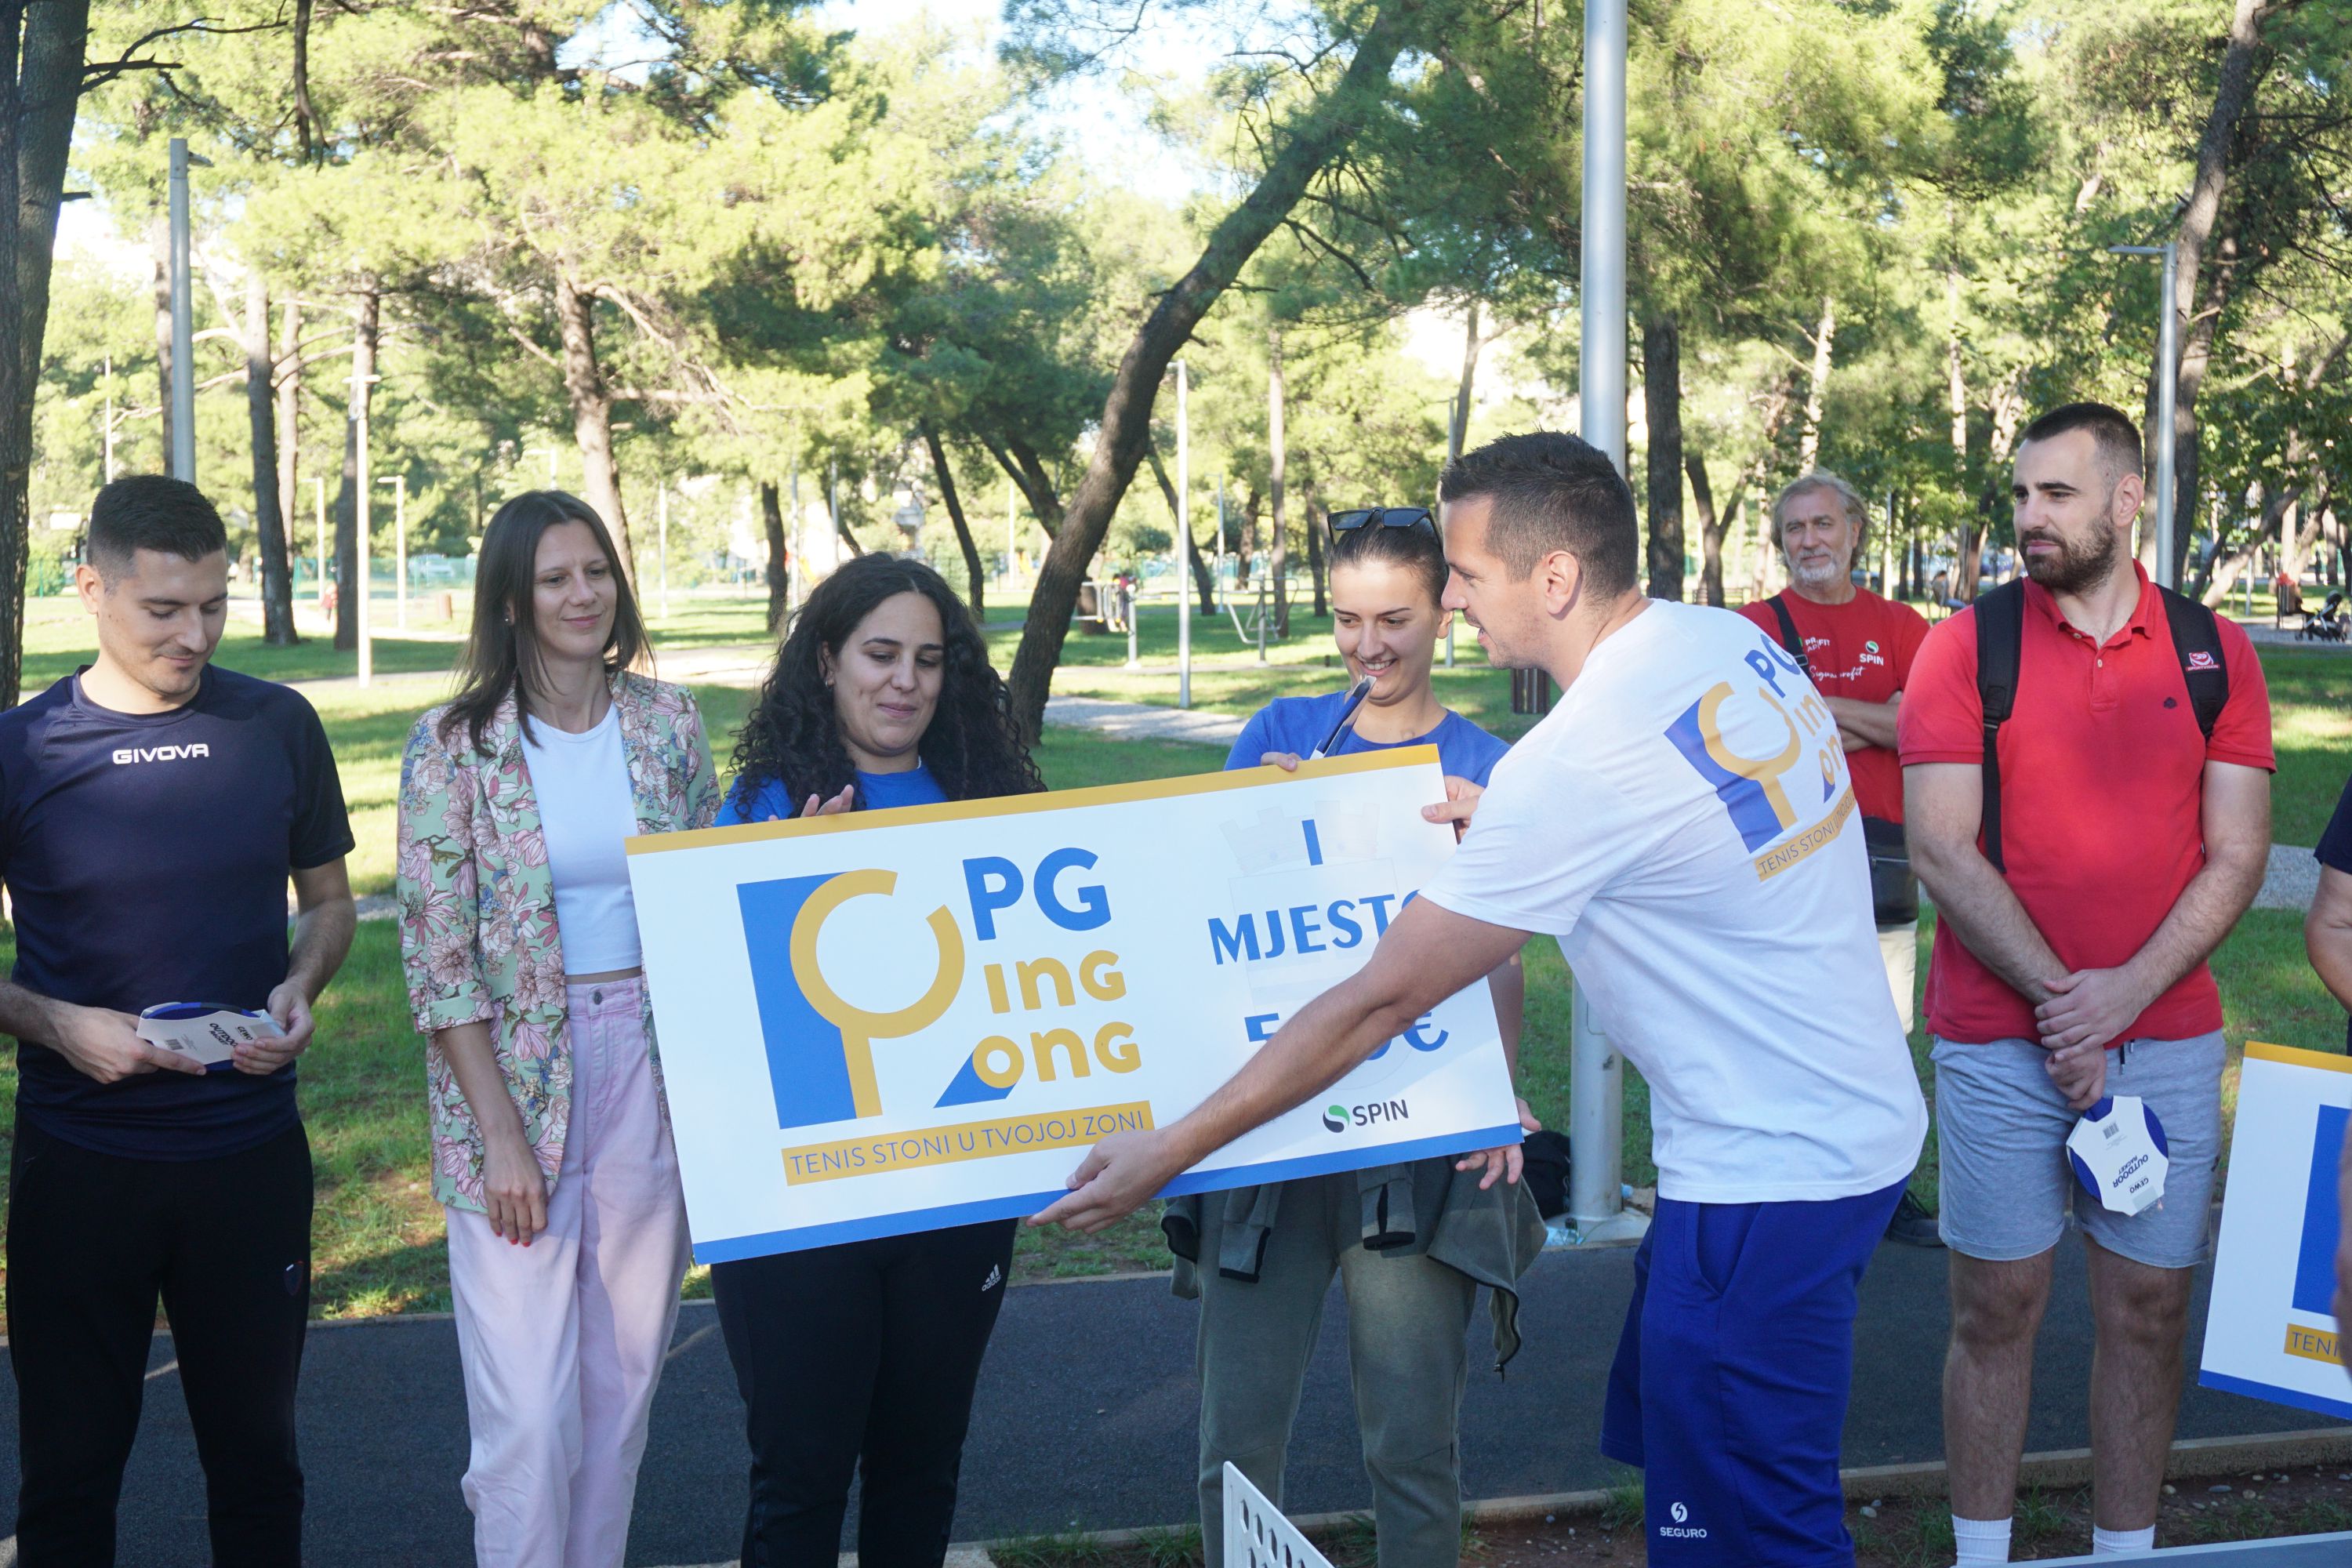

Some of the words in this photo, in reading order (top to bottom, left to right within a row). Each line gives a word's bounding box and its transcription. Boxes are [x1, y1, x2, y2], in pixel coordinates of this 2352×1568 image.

[1859, 653, 1884, 666] SPIN
[112, 743, 209, 764] GIVOVA
[1301, 818, 1323, 866] I
[1759, 844, 1800, 874] TENIS
[1799, 821, 1835, 852] STONI
[962, 847, 1112, 941] PG
[1207, 889, 1421, 965] MJEST
[209, 1022, 238, 1047] OUTDOO
[238, 1025, 253, 1040] GEWO
[1352, 1099, 1409, 1127] SPIN
[790, 1146, 866, 1176] TENIS
[874, 1134, 951, 1164] STONI
[958, 1131, 975, 1152] U
[982, 1118, 1076, 1149] TVOJOJ
[1083, 1109, 1144, 1137] ZONI
[2112, 1154, 2149, 1189] OUTDOOR
[2118, 1155, 2138, 1175] RACKET
[2129, 1178, 2149, 1194] GEWO
[2292, 1331, 2339, 1357] TENI
[1659, 1526, 1708, 1538] SEGURO
